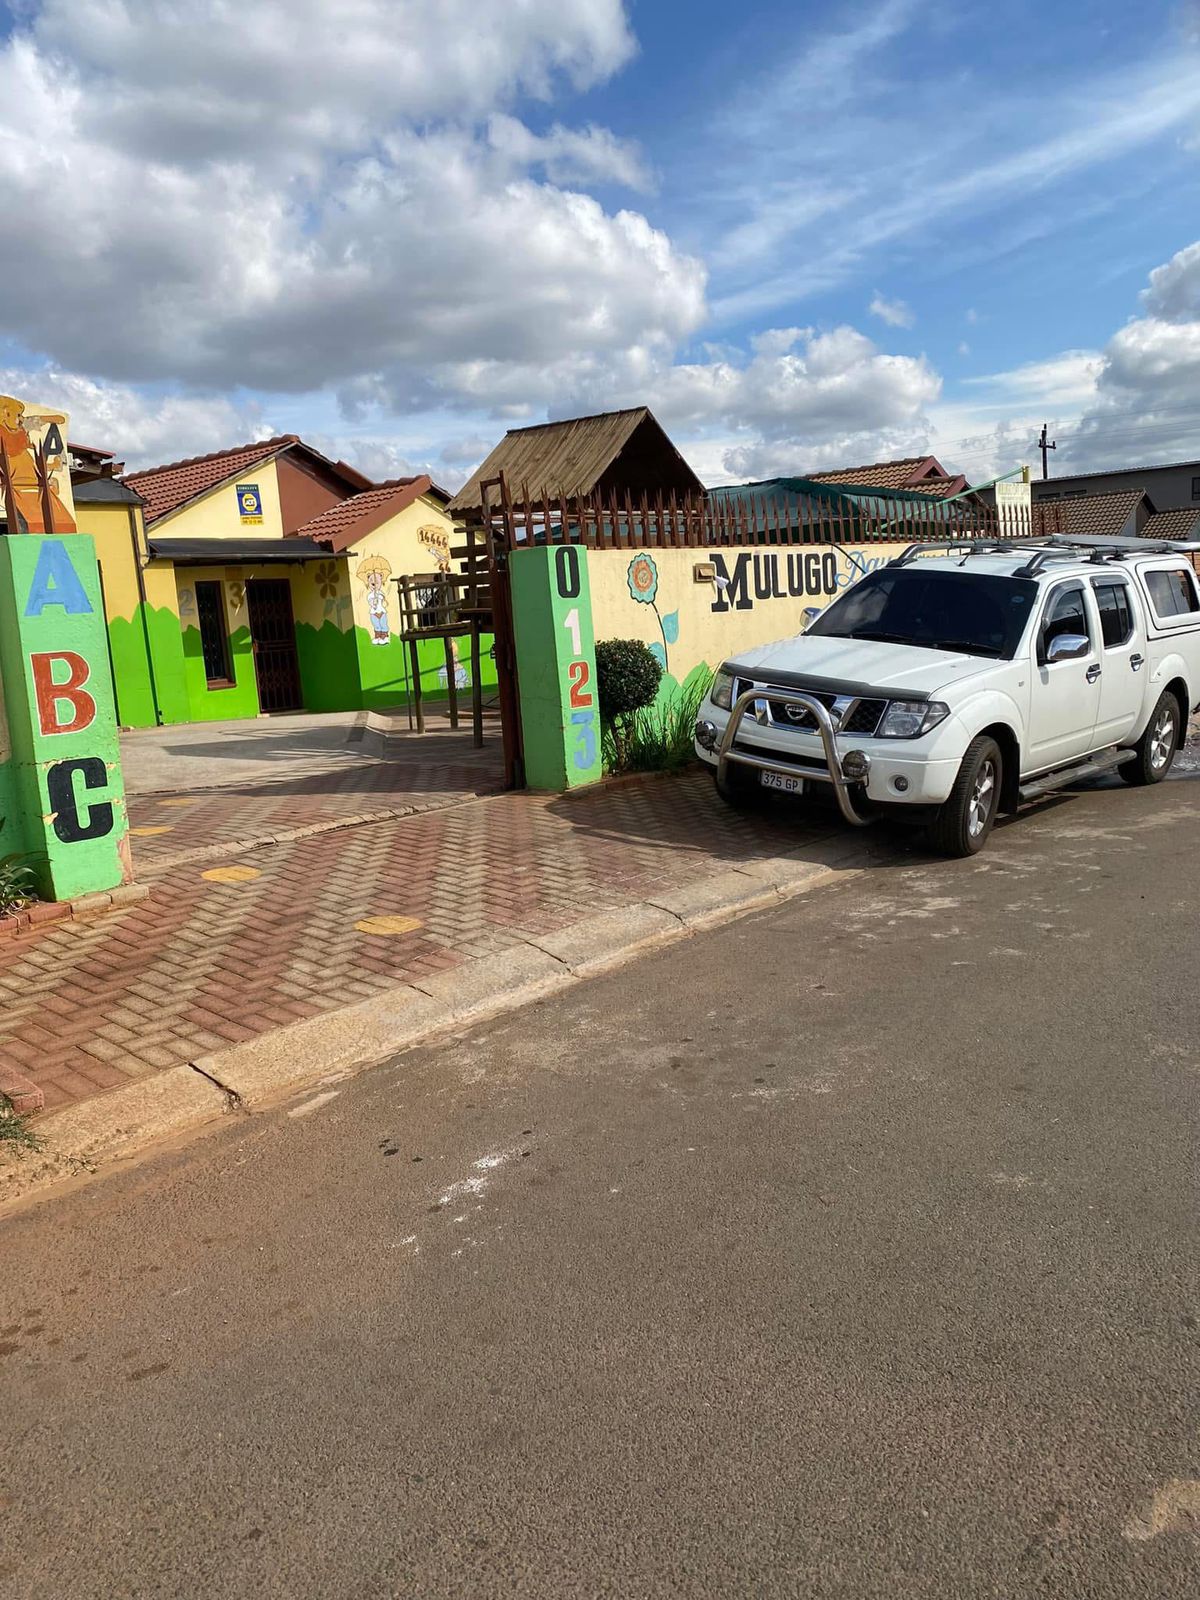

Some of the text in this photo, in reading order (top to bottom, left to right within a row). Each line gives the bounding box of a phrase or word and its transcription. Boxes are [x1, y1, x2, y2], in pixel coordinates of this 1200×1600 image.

[180, 582, 245, 617] 2 3
[709, 552, 838, 613] MULUGO
[555, 546, 597, 770] 0 1 2 3
[24, 540, 115, 844] A B C
[763, 773, 799, 791] 375 GP
